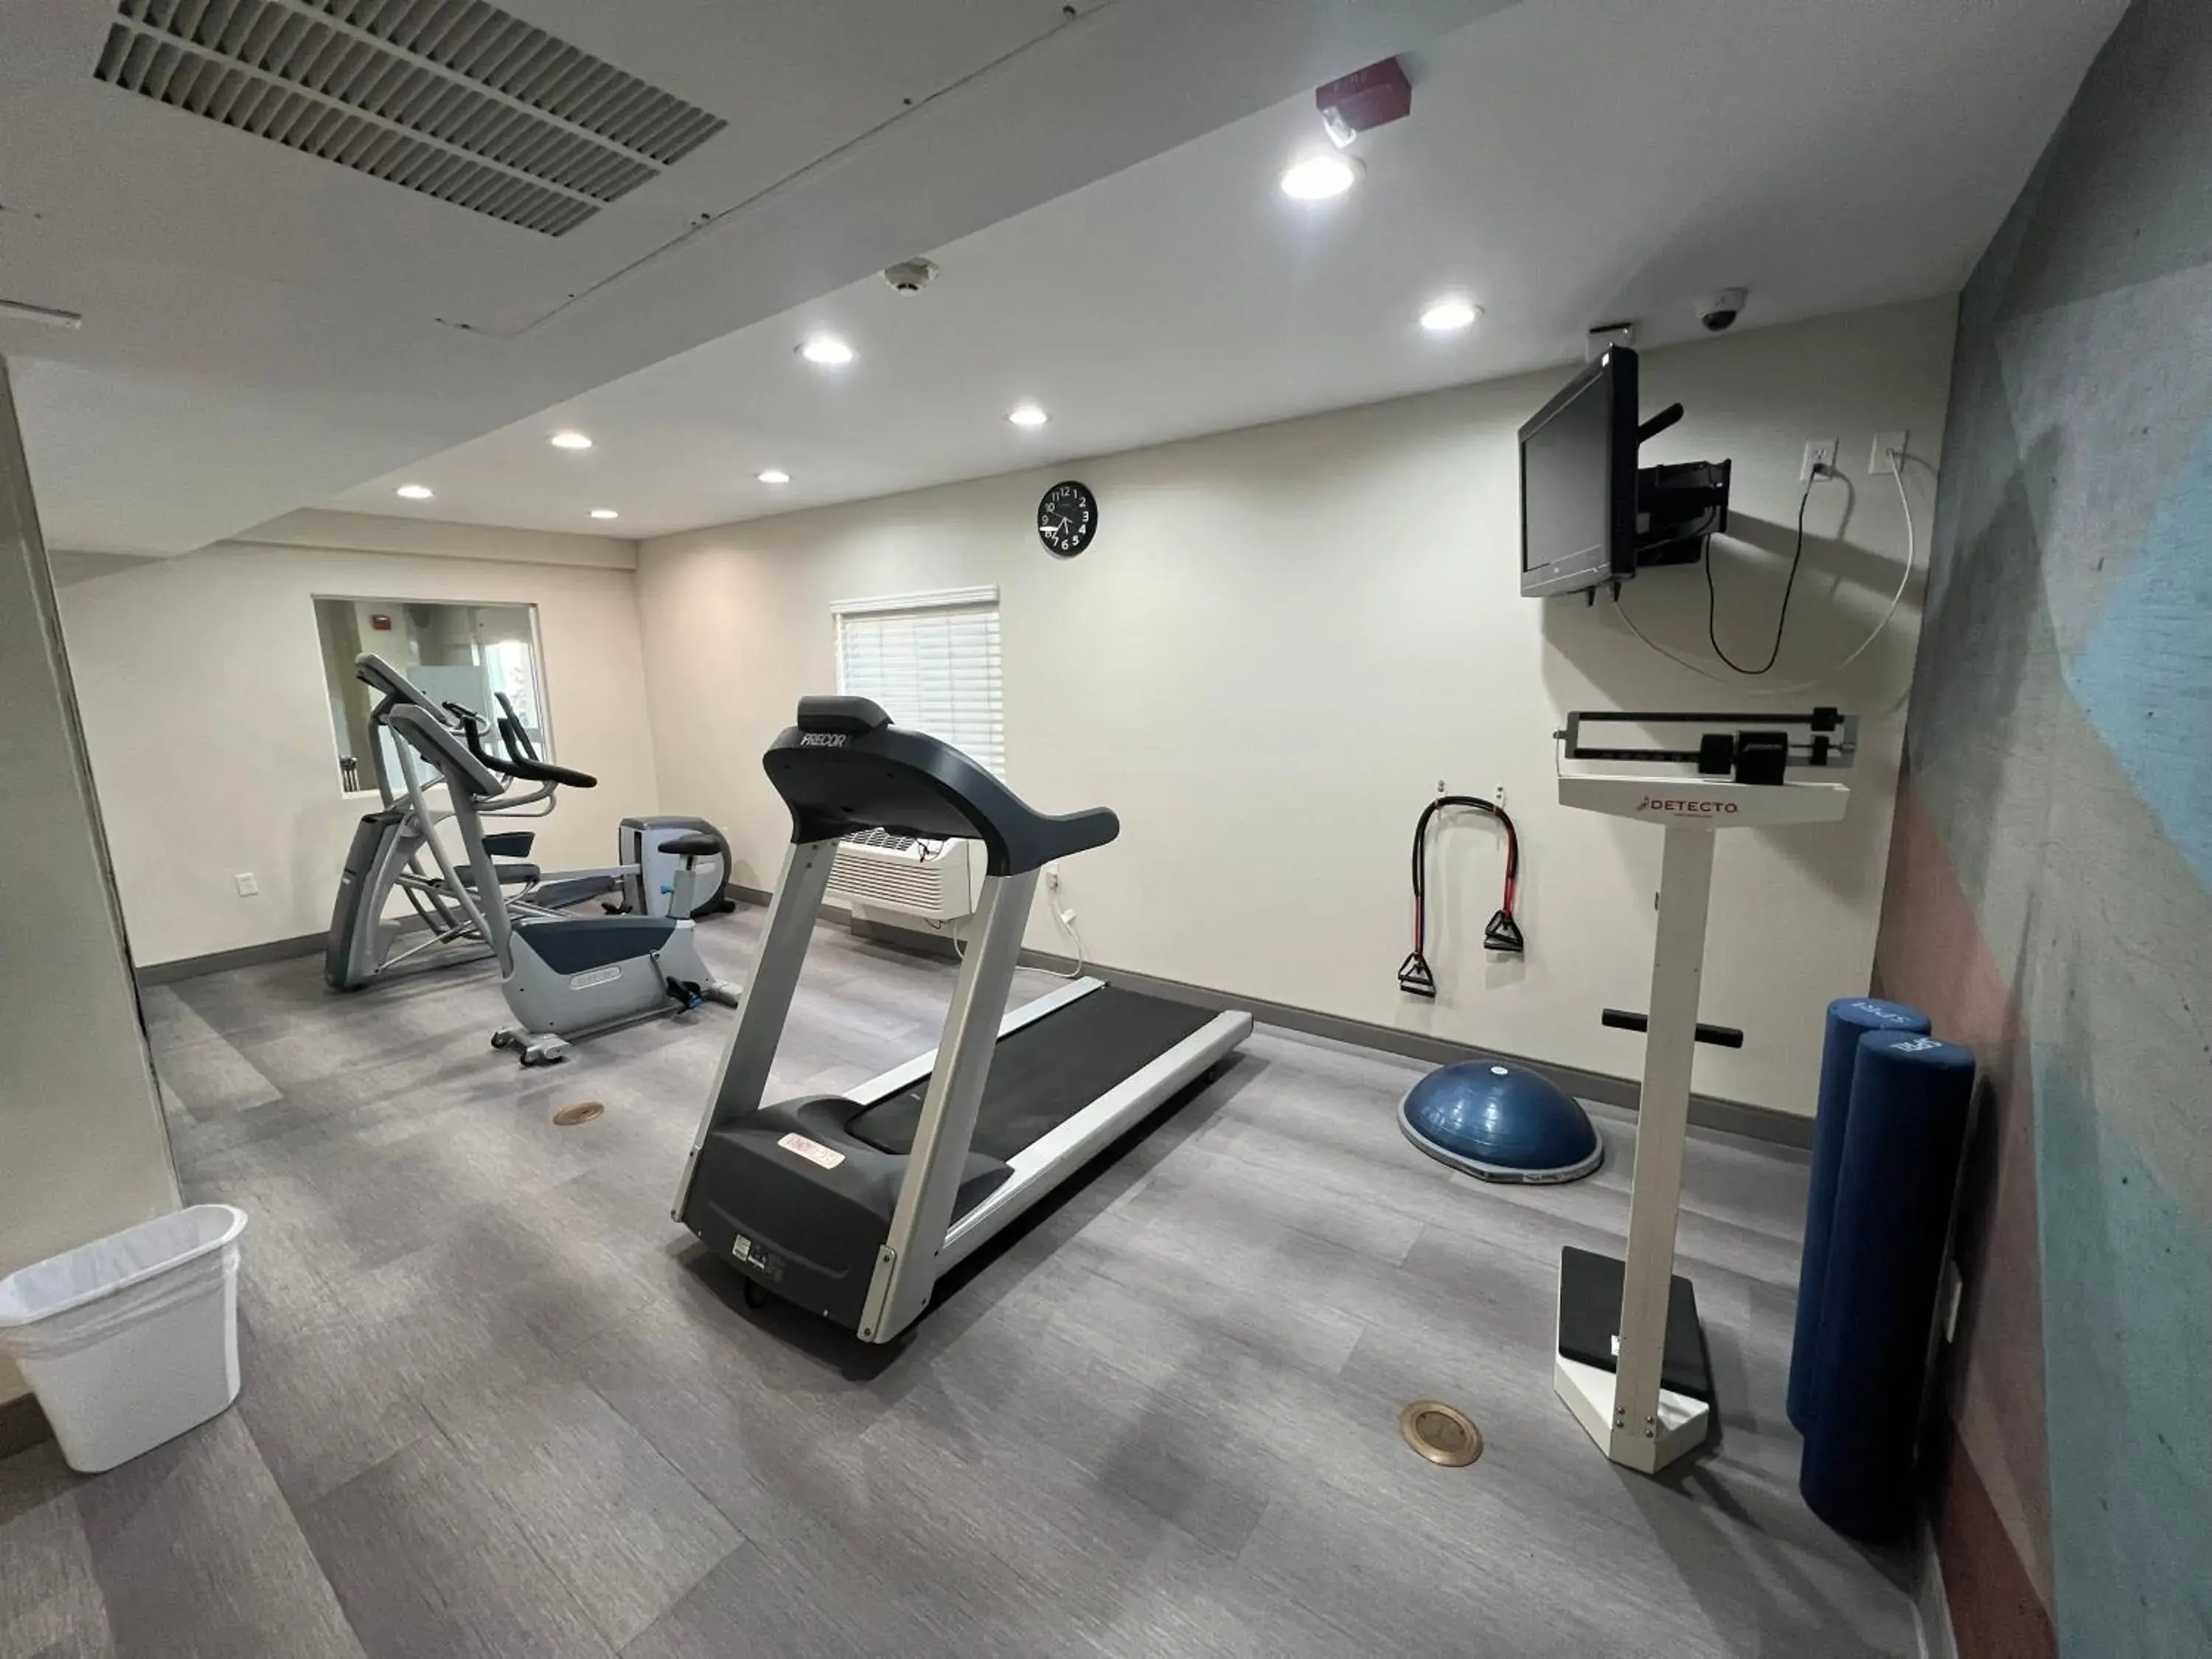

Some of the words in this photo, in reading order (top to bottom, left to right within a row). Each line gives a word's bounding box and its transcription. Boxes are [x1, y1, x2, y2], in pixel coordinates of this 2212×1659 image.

[1052, 492, 1060, 501] 11
[1060, 487, 1070, 496] 12
[1046, 502, 1055, 512] 10
[1079, 496, 1086, 507] 2
[1042, 515, 1048, 525] 9
[1082, 511, 1089, 522] 3
[1079, 524, 1086, 535] 4
[1053, 536, 1059, 546] 7
[1062, 539, 1068, 550] 6
[1073, 535, 1079, 546] 5
[800, 733, 846, 748] PRECOR
[1650, 800, 1738, 813] DETECTO
